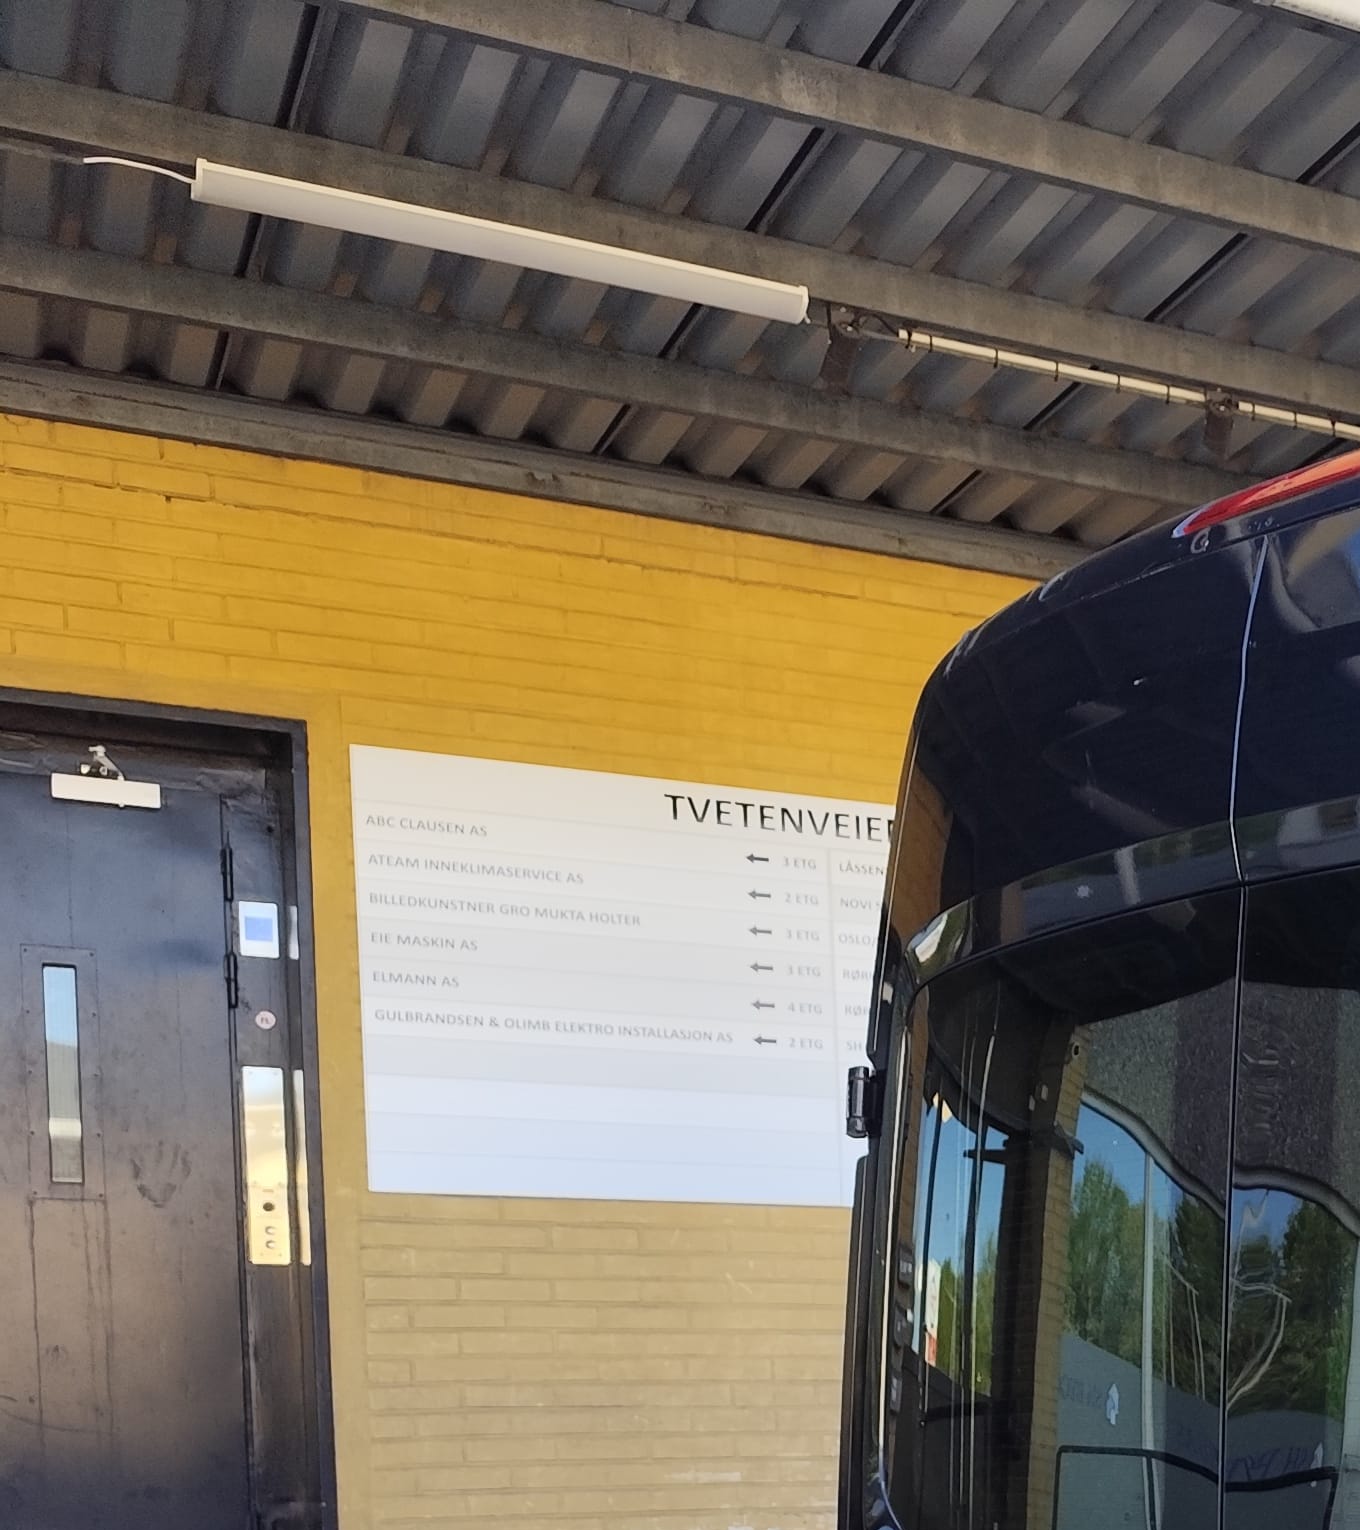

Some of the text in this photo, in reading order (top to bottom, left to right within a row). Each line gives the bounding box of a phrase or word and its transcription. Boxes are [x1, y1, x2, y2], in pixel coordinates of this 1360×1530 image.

[366, 814, 488, 838] ABC CLAUSEN AS
[368, 853, 584, 885] ATEAM INNEKLIMASERVICE AS
[793, 858, 817, 871] ETG
[795, 893, 819, 906] ETG
[840, 897, 872, 910] NOVI
[369, 892, 641, 927] BILLEDKUNSTNER GRO MUKTA HOLTER
[370, 931, 478, 952] EIE MASKIN AS
[796, 929, 820, 942] ETG
[798, 966, 822, 978] ETG
[372, 970, 460, 989] ELMANN AS
[799, 1003, 823, 1015] ETG
[374, 1008, 734, 1044] GULBRANDSEN & OLIMB ELEKTRO INSTALLASJON AS
[800, 1038, 824, 1050] ETG
